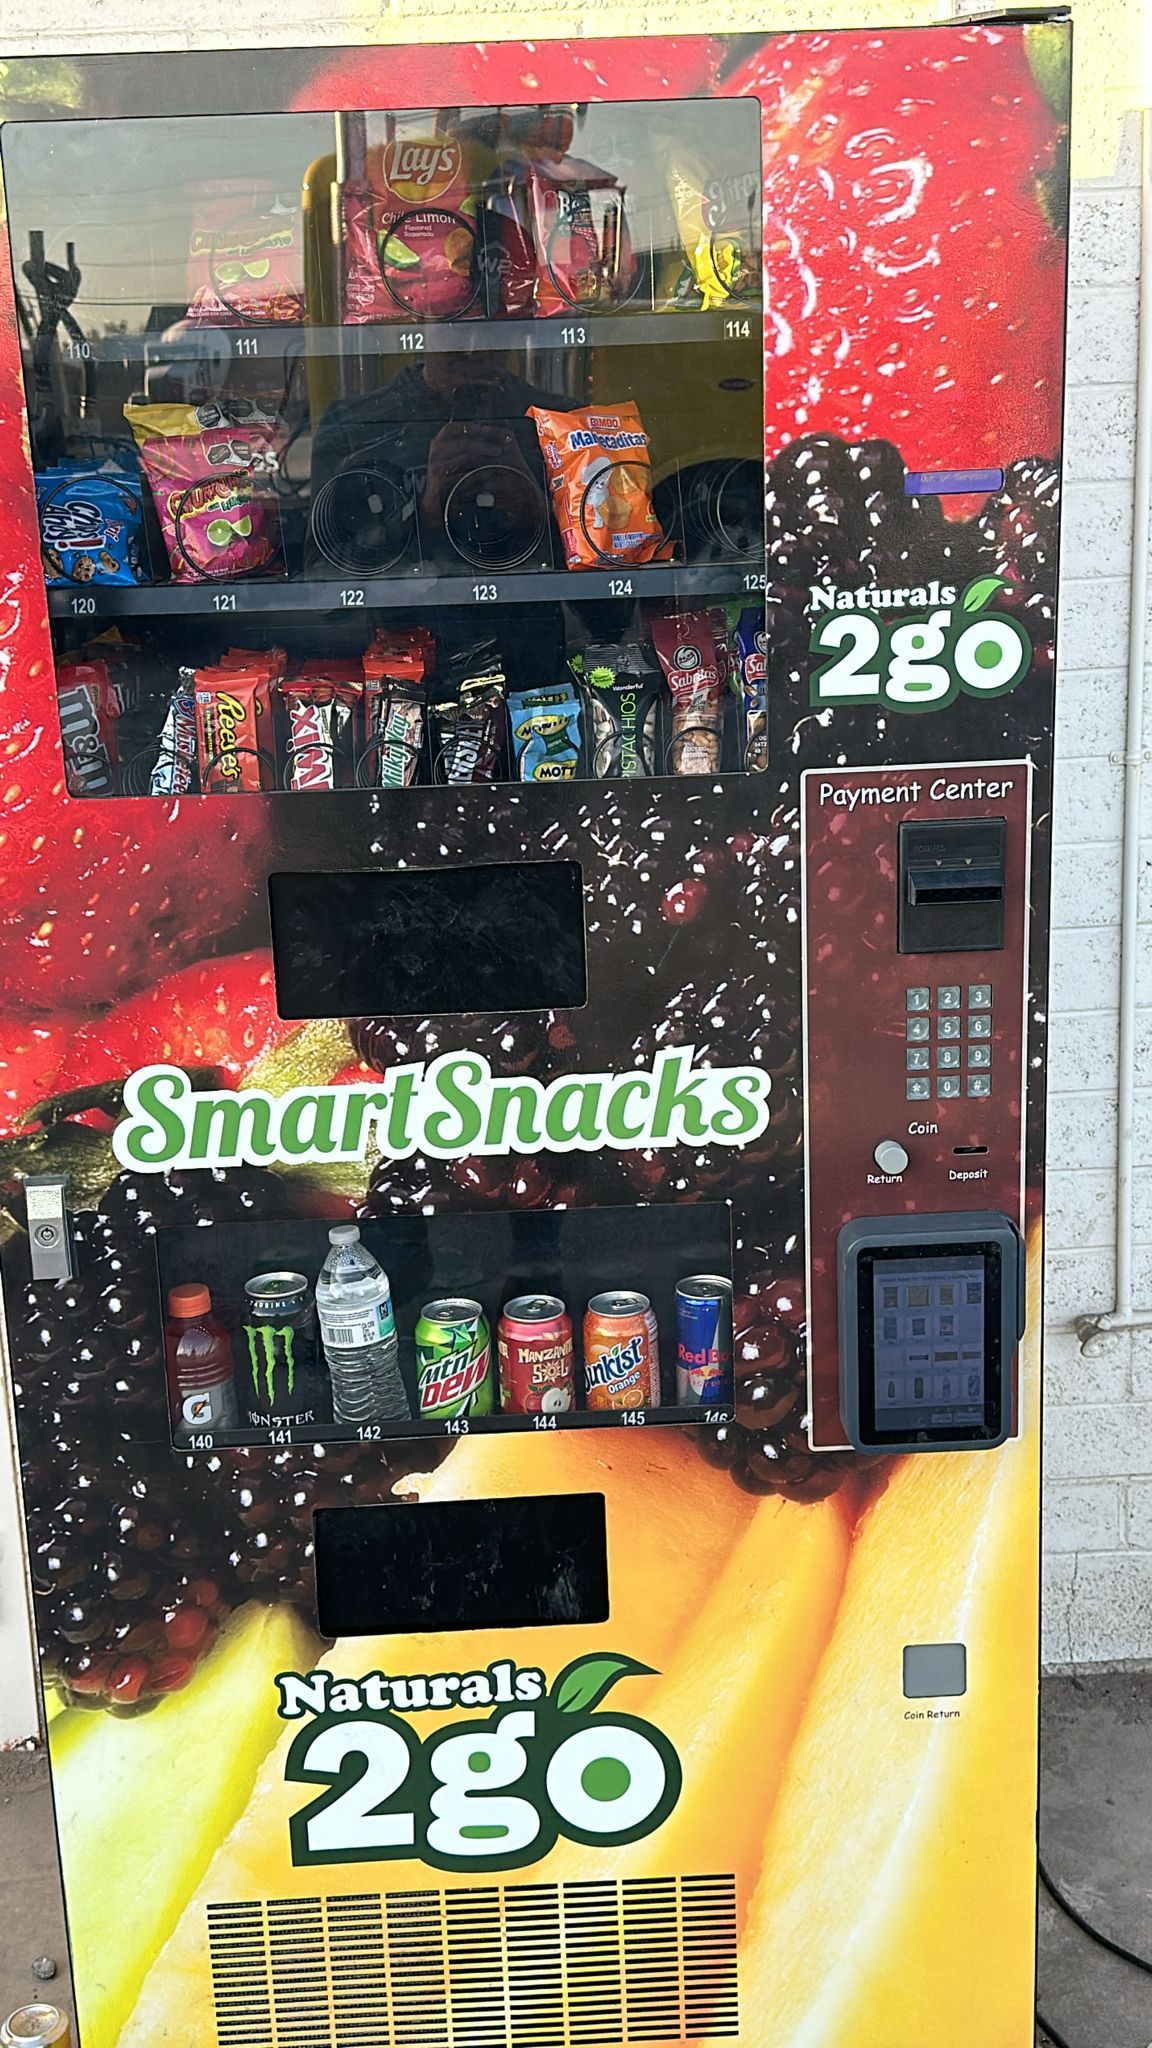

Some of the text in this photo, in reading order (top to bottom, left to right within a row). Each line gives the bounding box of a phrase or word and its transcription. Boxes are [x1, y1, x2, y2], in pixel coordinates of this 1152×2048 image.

[389, 142, 456, 186] Lay's
[560, 327, 587, 345] 113
[725, 320, 751, 338] 114
[235, 338, 258, 356] 111
[399, 332, 425, 351] 112
[67, 342, 91, 359] 110
[590, 417, 619, 428] BIMBO
[608, 579, 633, 596] 124
[743, 574, 766, 590] 125
[339, 589, 365, 607] 122
[472, 585, 498, 601] 123
[808, 581, 957, 612] Naturals
[71, 598, 96, 614] 120
[212, 595, 237, 611] 121
[819, 609, 1023, 704] 2go
[613, 683, 644, 692] Wonderful
[820, 778, 1013, 812] Payment Center
[914, 991, 982, 1006] 1 2 3
[913, 1021, 982, 1034] 4 5 6
[914, 1050, 981, 1064] 7 8 9
[944, 1081, 950, 1091] 0
[125, 1055, 762, 1164] SmartSnacks
[908, 1122, 939, 1135] Coin
[867, 1174, 903, 1185] Return
[949, 1169, 989, 1182] Deposit
[678, 1343, 706, 1364] Red
[420, 1351, 470, 1386] Mtn
[608, 1371, 641, 1394] Orange
[532, 1416, 557, 1430] 144
[621, 1412, 645, 1425] 145
[356, 1426, 381, 1440] 142
[444, 1420, 469, 1434] 143
[188, 1435, 214, 1449] 140
[268, 1429, 292, 1444] 141
[279, 1664, 542, 1717] Naturals
[904, 1710, 960, 1720] Coin Return
[303, 1711, 667, 1857] 2go
